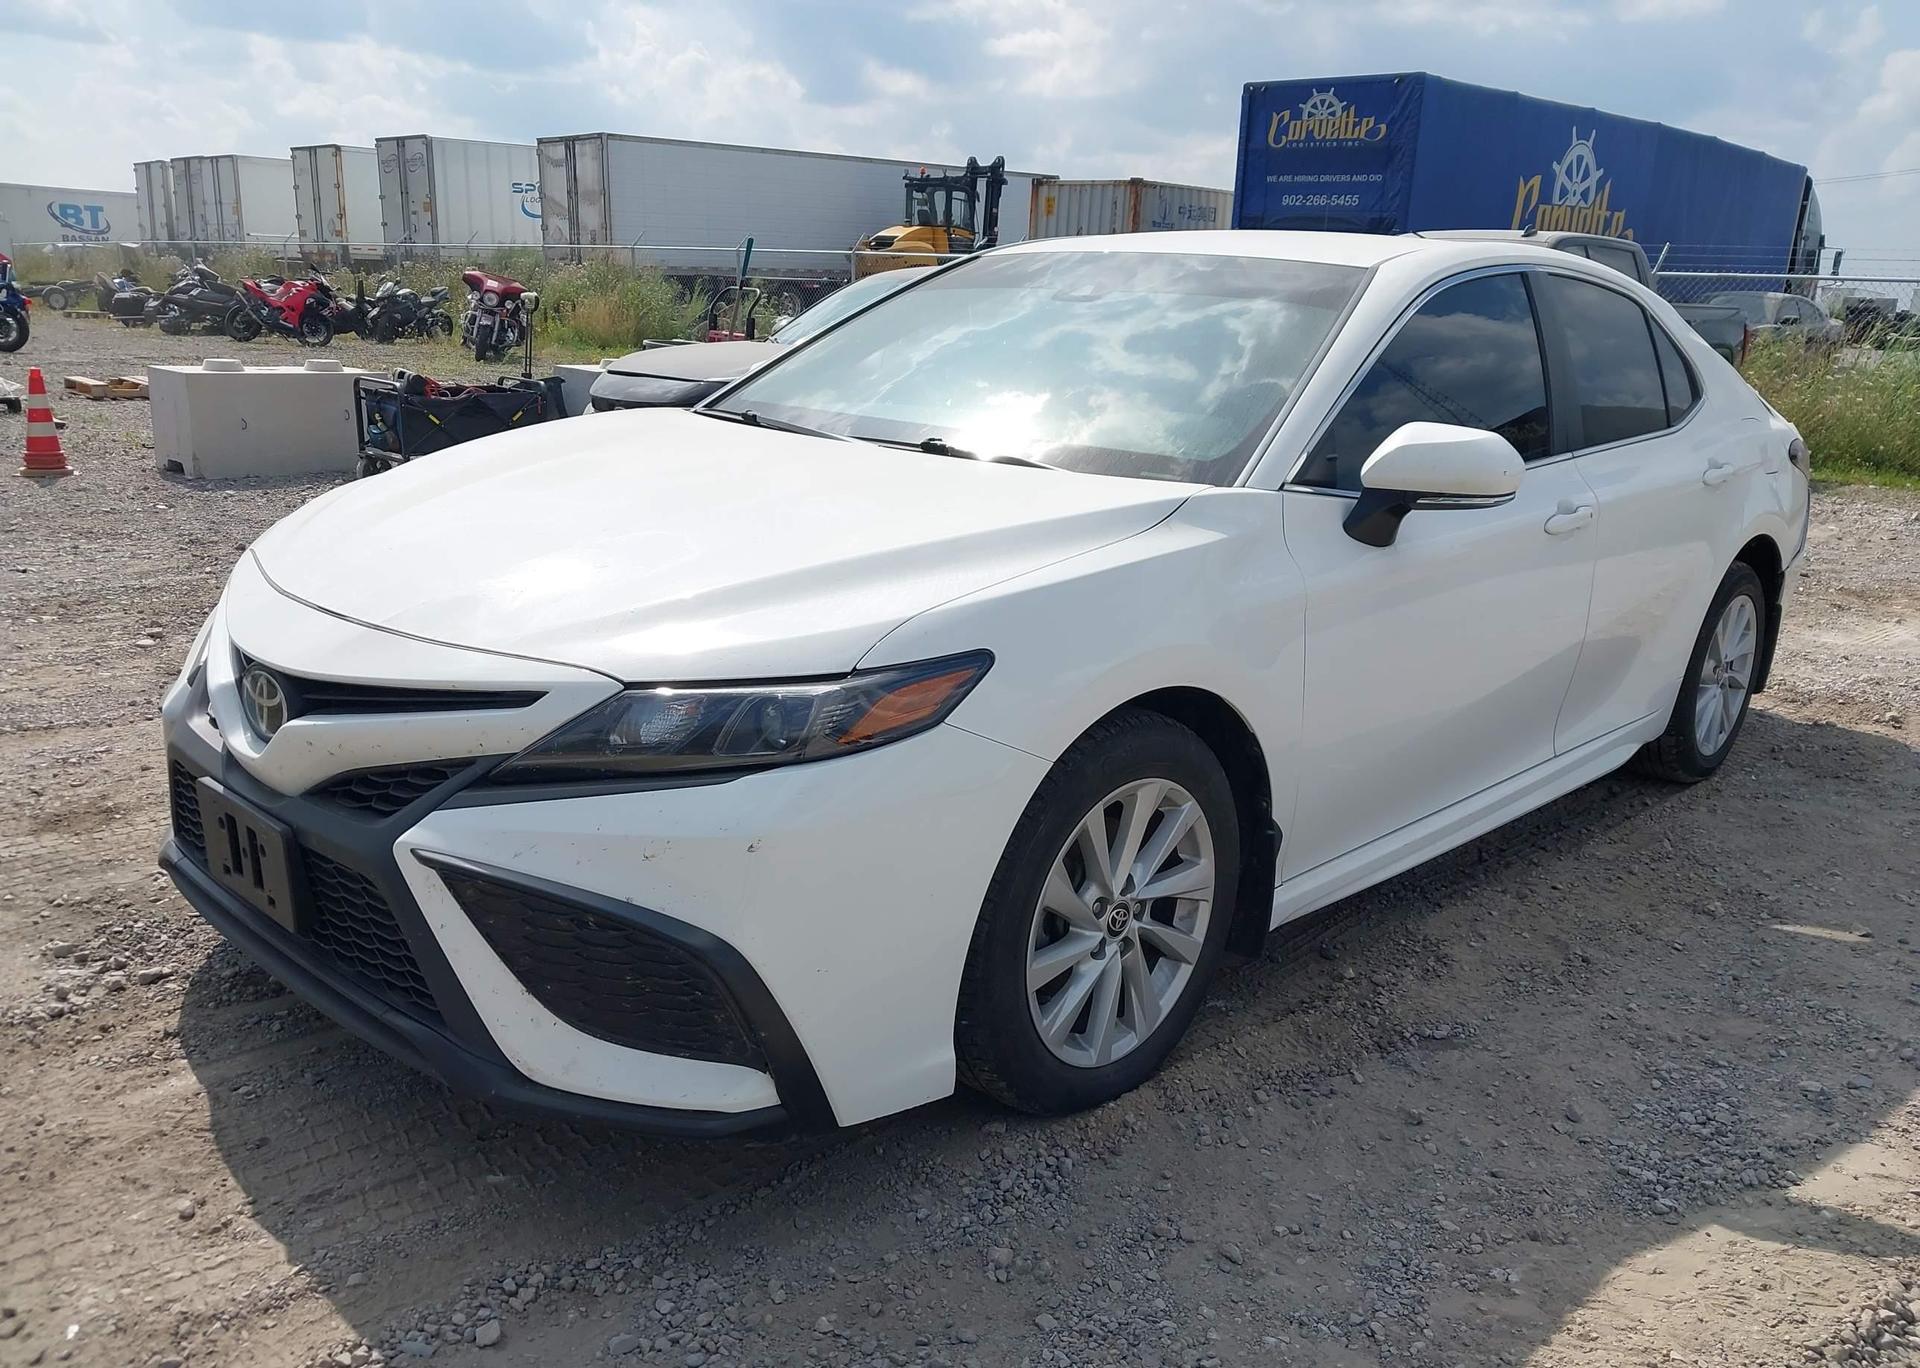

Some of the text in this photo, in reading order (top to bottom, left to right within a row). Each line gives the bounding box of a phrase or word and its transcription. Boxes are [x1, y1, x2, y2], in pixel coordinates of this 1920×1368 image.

[1268, 104, 1387, 148] Corvette
[1266, 174, 1278, 183] WE
[1279, 174, 1293, 182] ARE
[1294, 174, 1319, 182] HIRING
[1320, 174, 1351, 182] DRIVERS
[1281, 194, 1360, 206] 902-266-5455
[58, 203, 104, 229] BT
